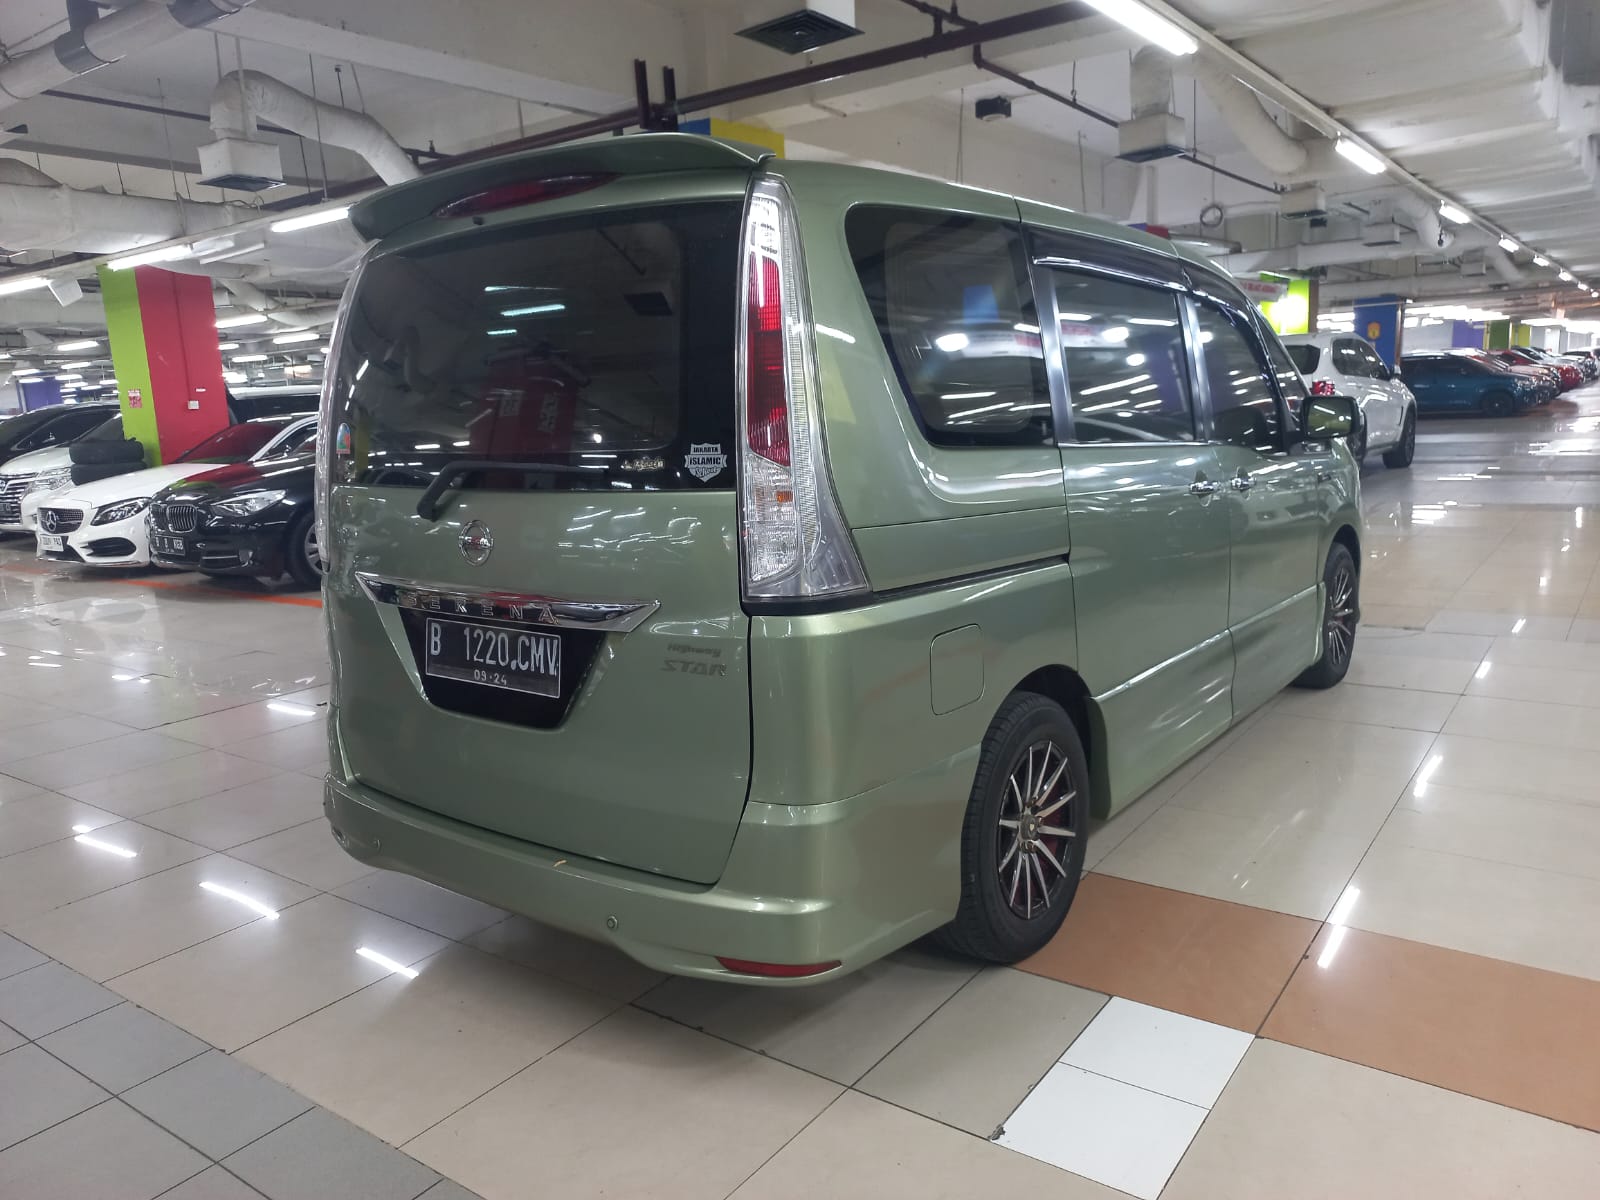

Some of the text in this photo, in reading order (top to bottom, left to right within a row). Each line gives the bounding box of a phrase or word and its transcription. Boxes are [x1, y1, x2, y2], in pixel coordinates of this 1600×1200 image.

[689, 456, 721, 465] ISLAMIC
[406, 592, 556, 624] SERENA
[430, 622, 442, 656] B
[667, 643, 722, 658] Highway
[660, 659, 727, 677] STAR
